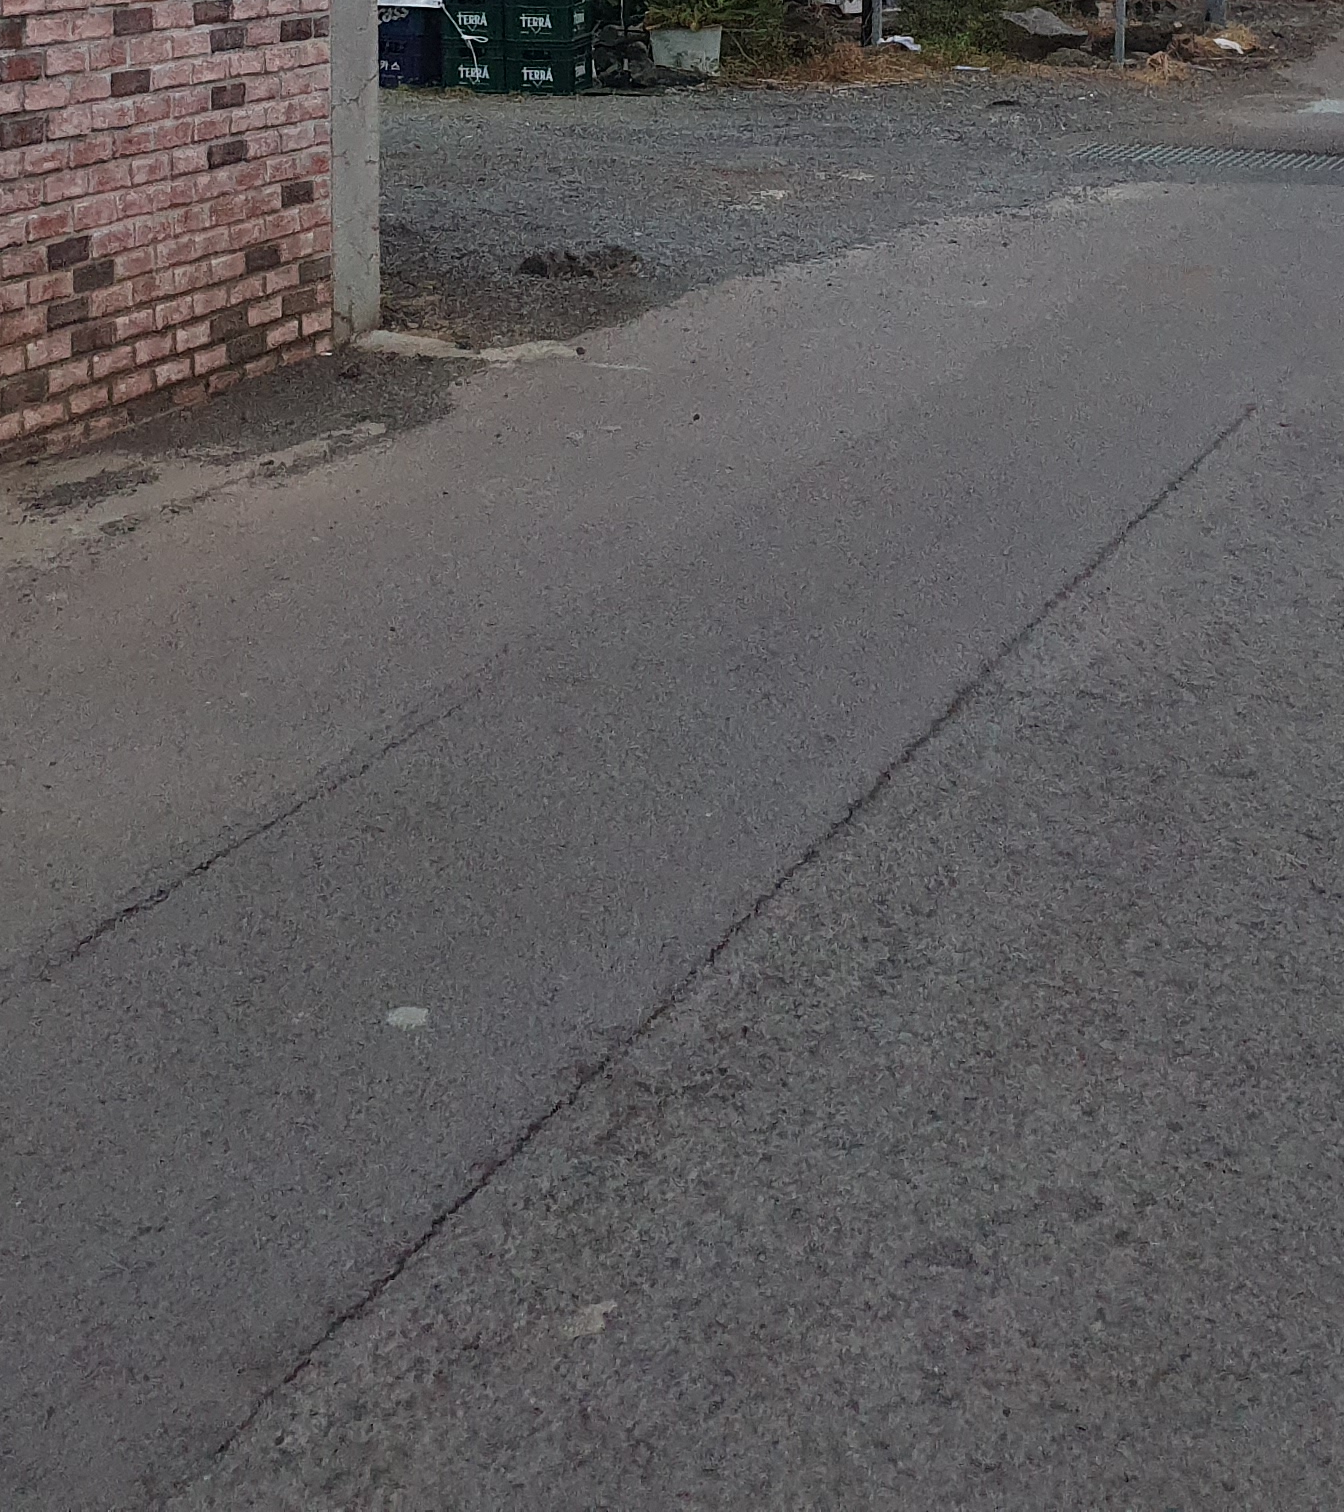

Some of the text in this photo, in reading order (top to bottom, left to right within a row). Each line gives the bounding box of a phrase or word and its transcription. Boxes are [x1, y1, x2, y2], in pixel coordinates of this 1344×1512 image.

[457, 12, 488, 27] TERRA
[520, 13, 552, 29] TERRA
[521, 66, 554, 82] TERRA
